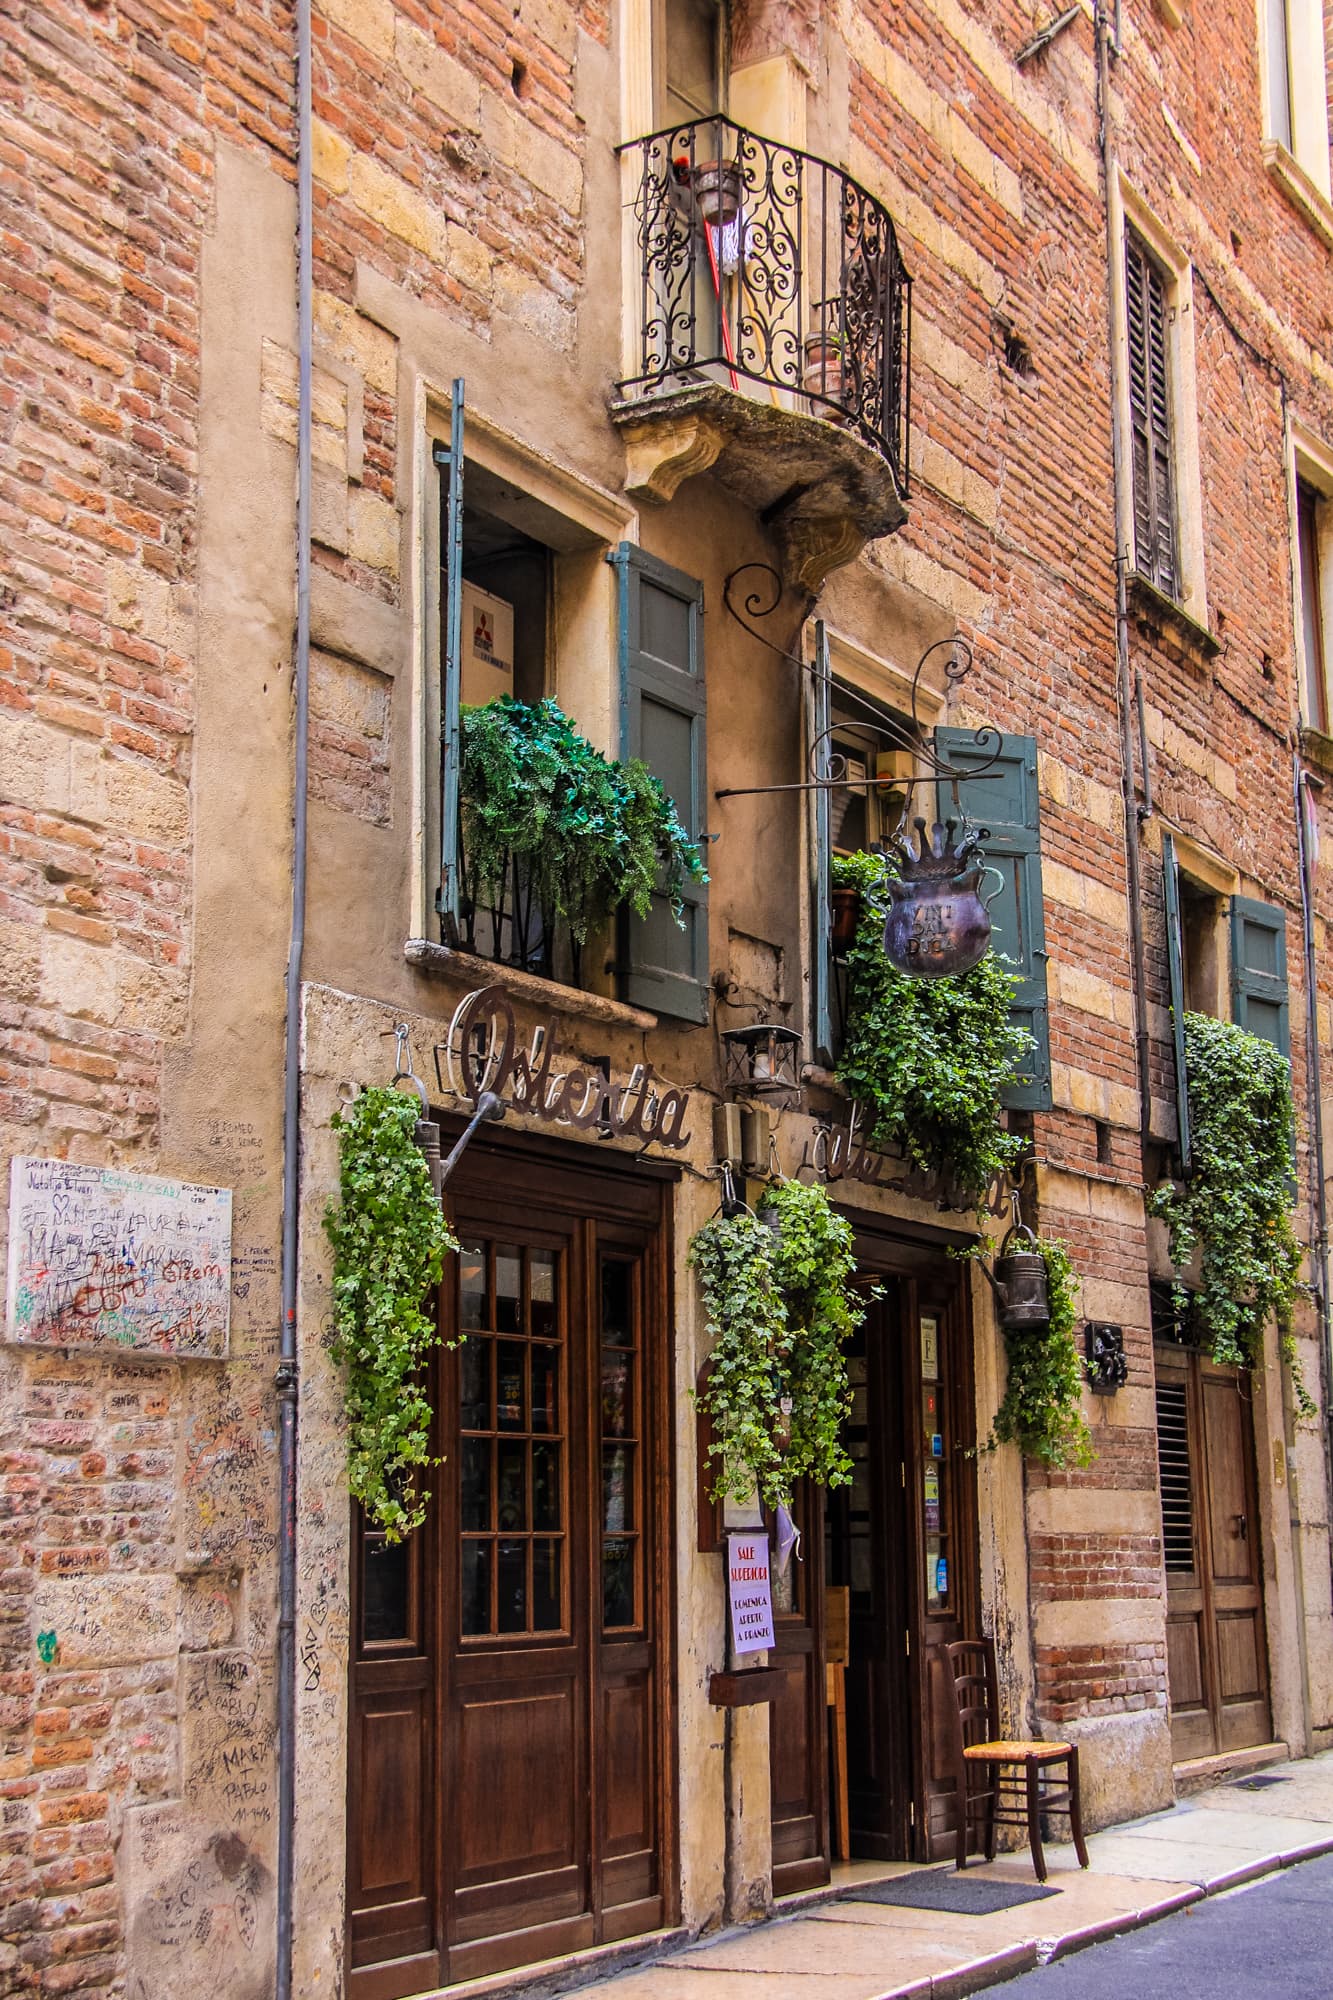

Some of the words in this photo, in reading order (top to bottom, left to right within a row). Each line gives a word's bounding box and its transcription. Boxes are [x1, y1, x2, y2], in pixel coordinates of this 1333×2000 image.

[906, 936, 957, 955] DUCA
[460, 983, 692, 1150] Osteria
[737, 1546, 756, 1561] SALE
[734, 1596, 768, 1610] DOMENICA
[739, 1612, 763, 1625] APERTO
[744, 1626, 770, 1641] PRANZO
[215, 1656, 248, 1681] MARTA
